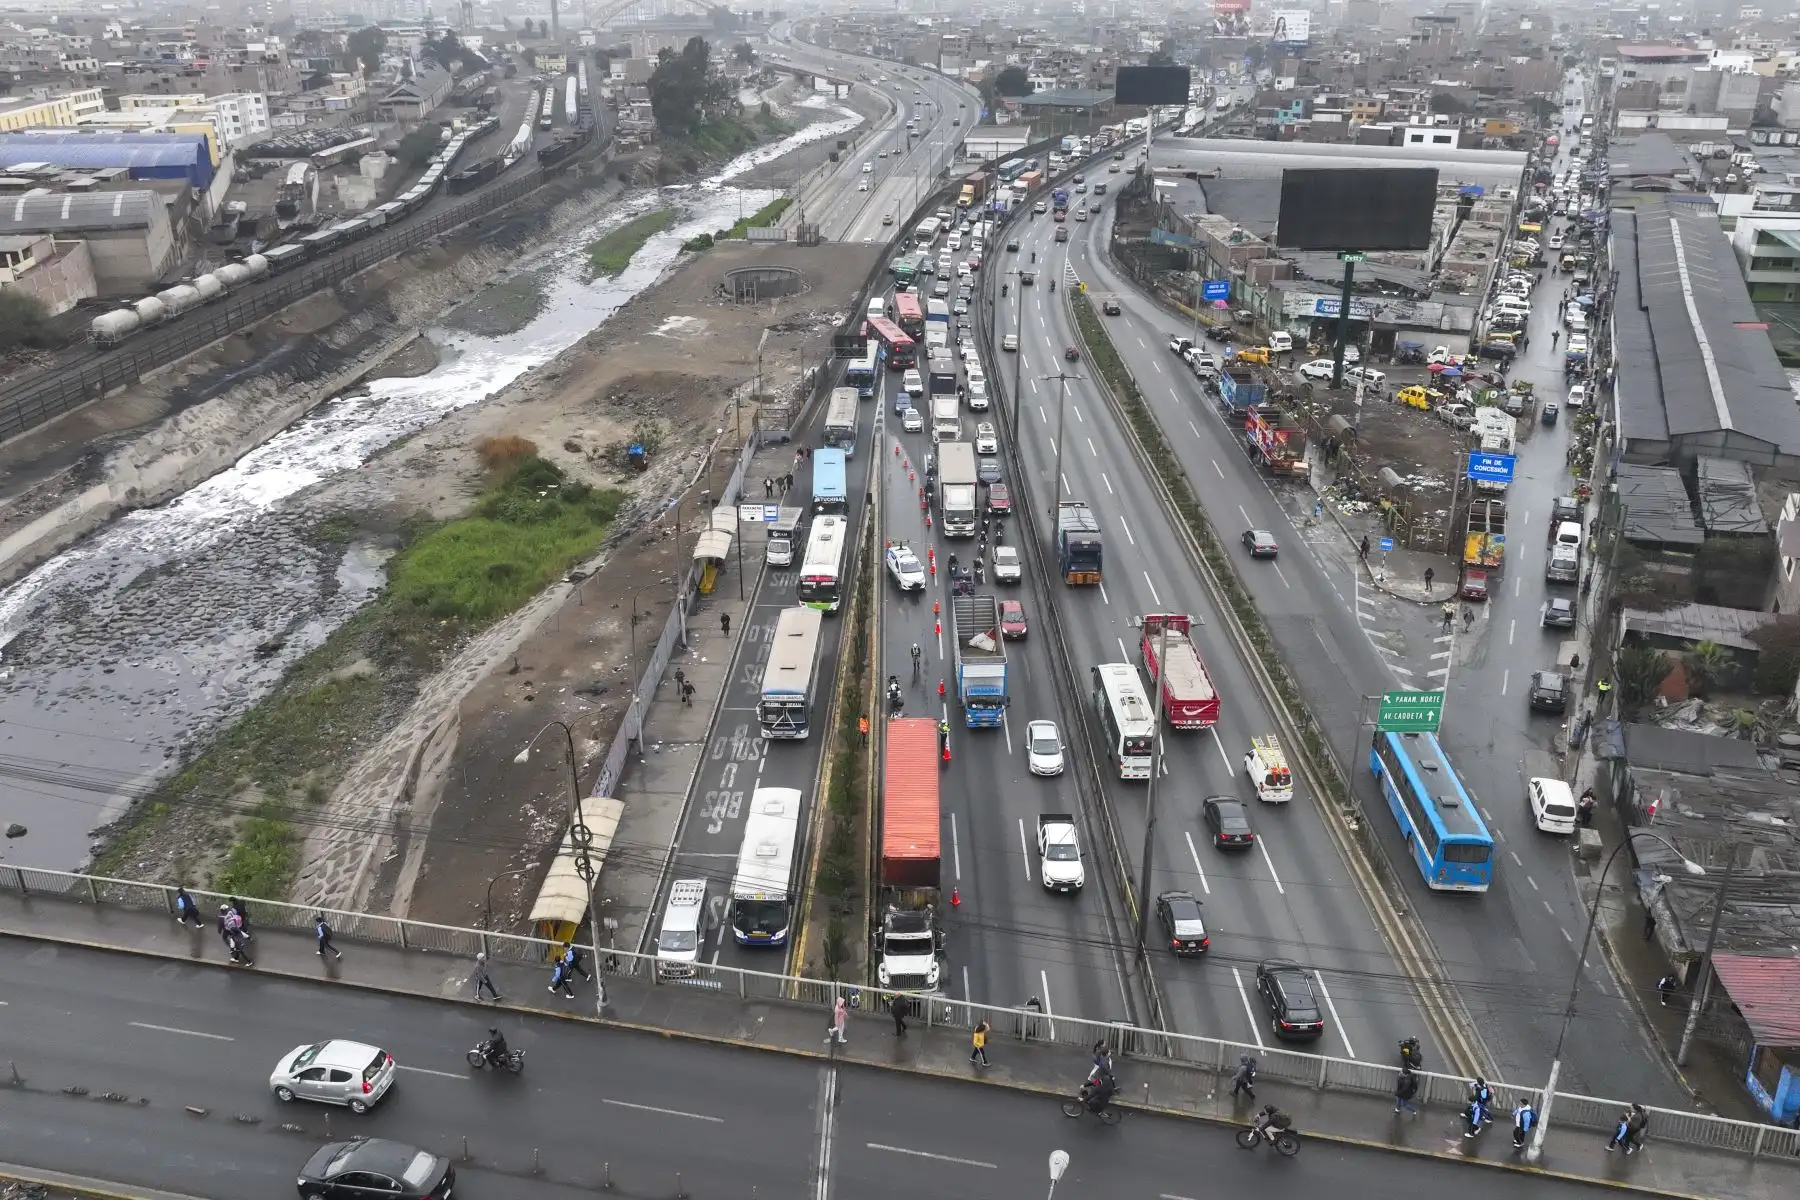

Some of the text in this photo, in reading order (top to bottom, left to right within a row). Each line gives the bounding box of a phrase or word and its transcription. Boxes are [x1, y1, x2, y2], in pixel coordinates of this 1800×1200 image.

[1350, 308, 1371, 316] ROSA
[1474, 464, 1509, 474] CONCESIÓN
[1420, 695, 1441, 703] NORTE
[1393, 712, 1423, 720] CAQUETA
